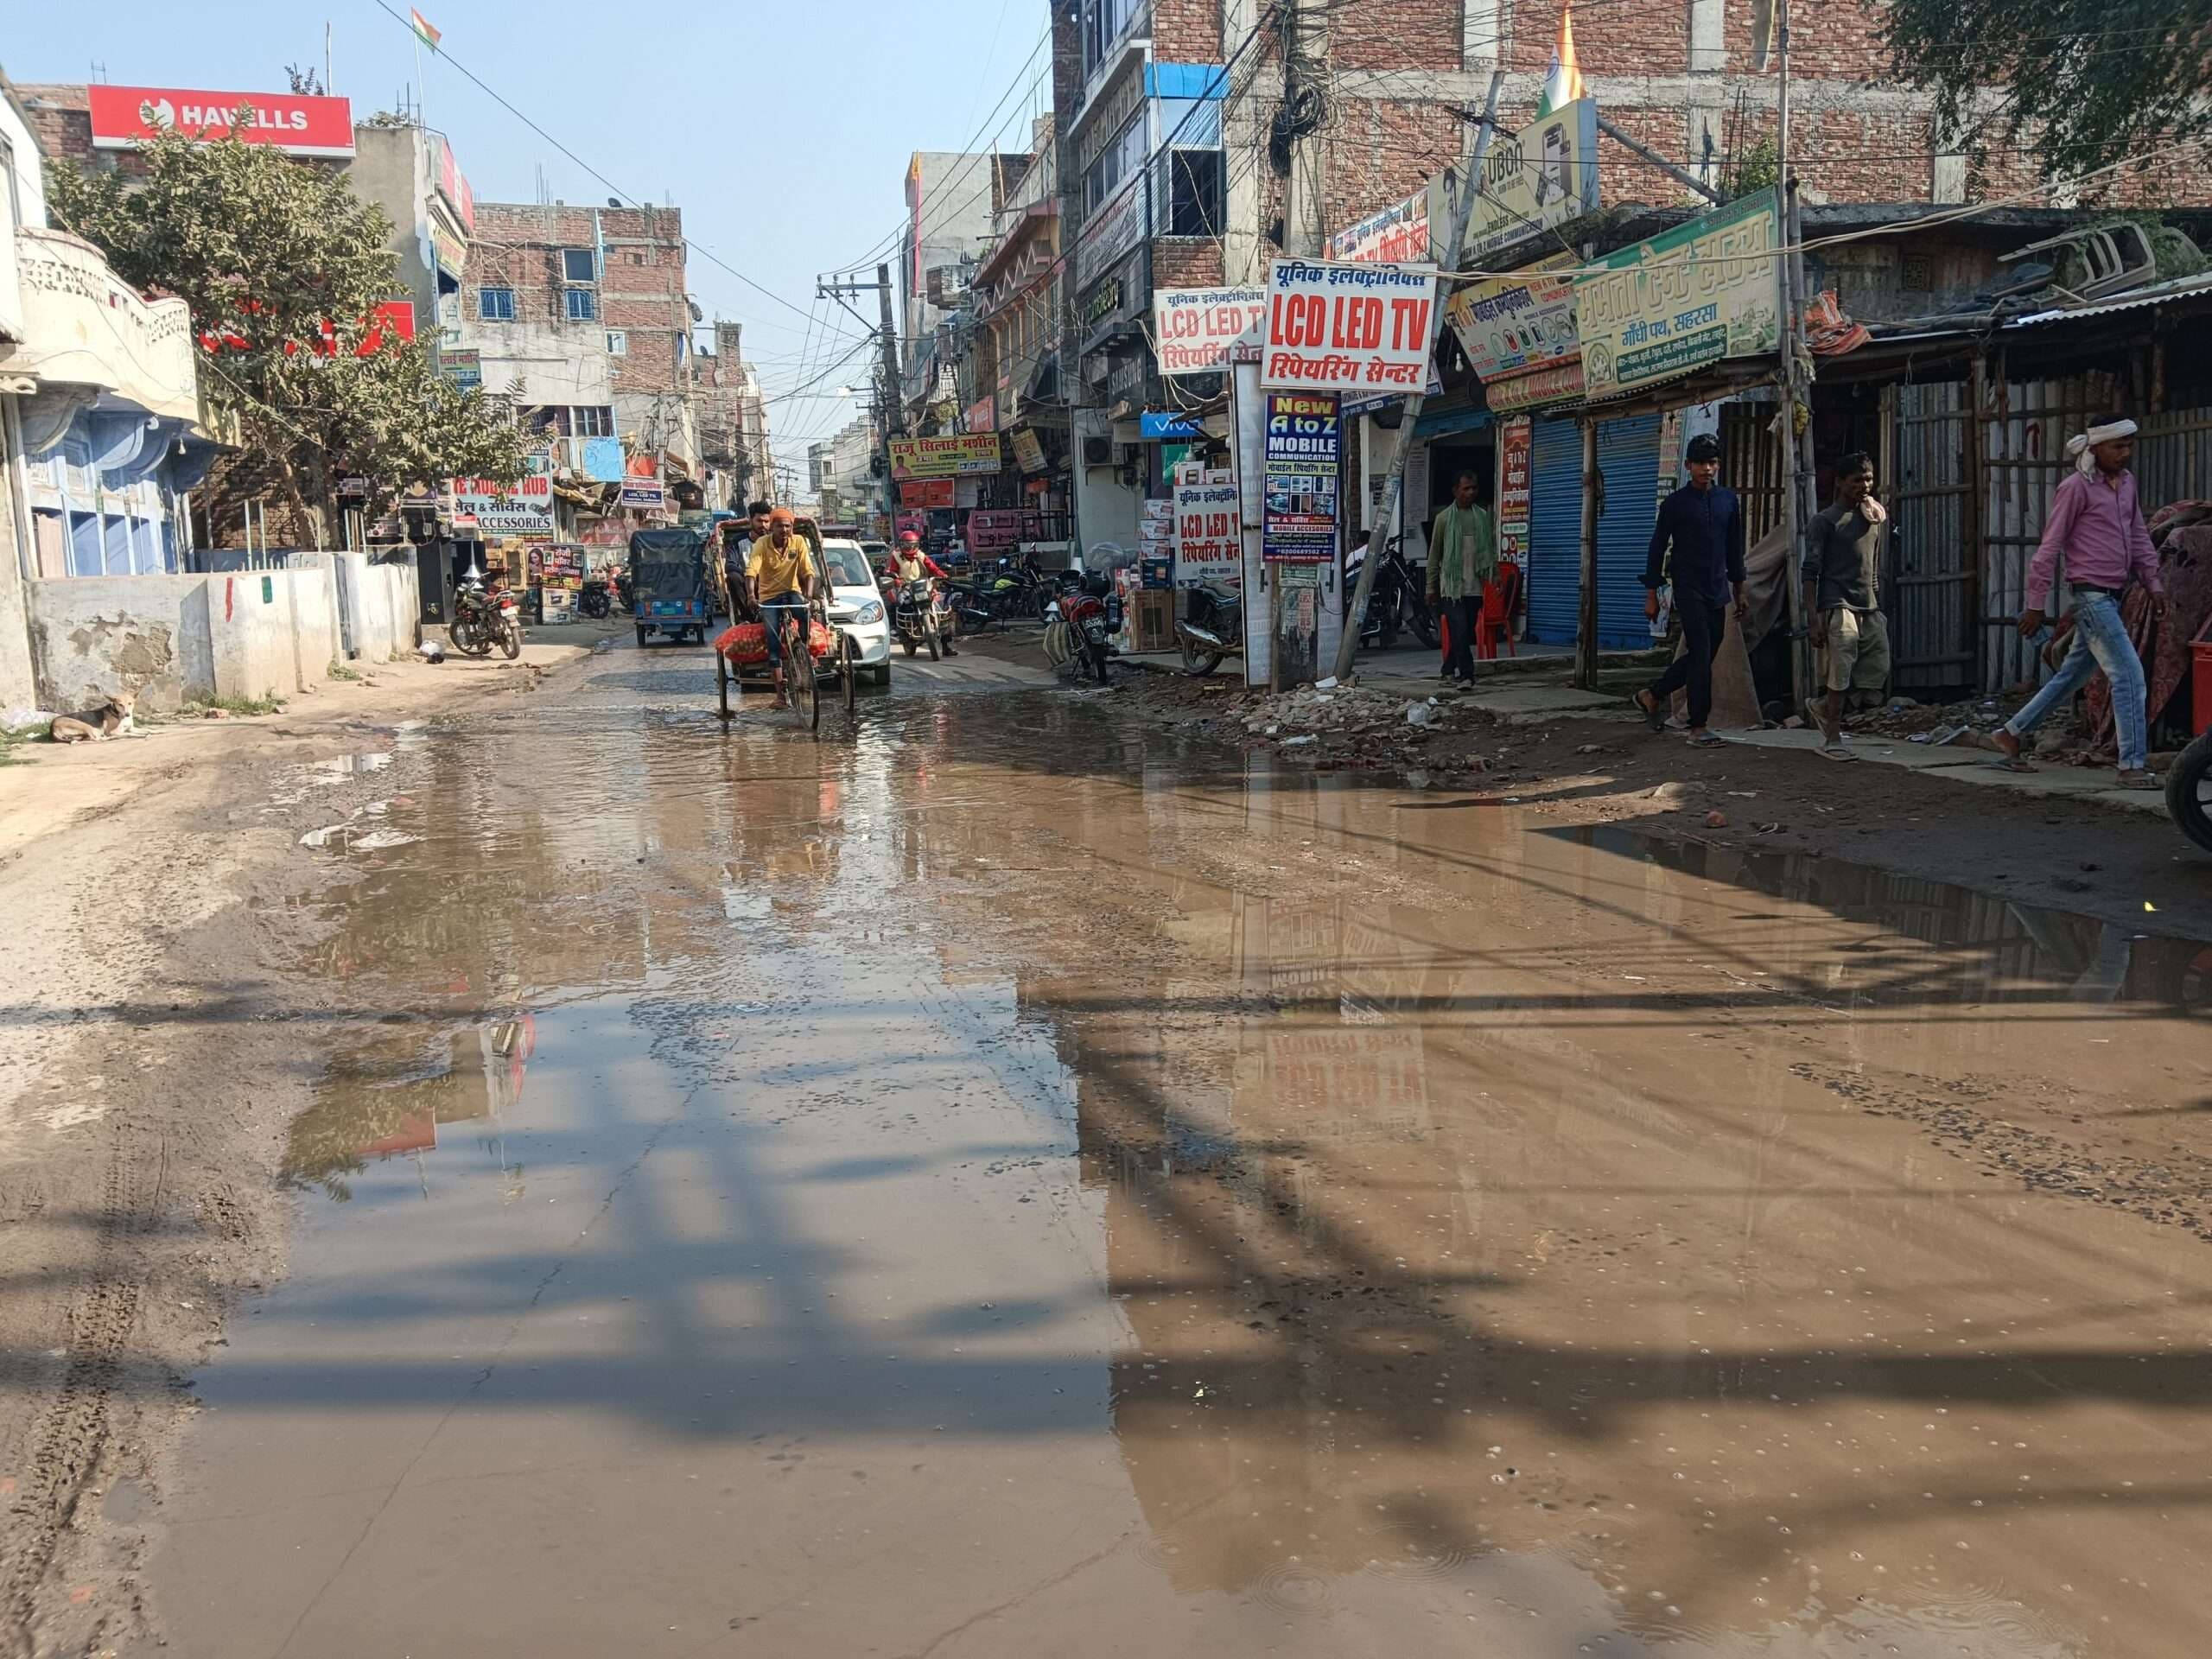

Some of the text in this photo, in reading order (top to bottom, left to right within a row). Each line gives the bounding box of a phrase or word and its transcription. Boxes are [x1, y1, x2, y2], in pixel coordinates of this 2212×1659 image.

[182, 105, 308, 130] HAVELLS
[1276, 261, 1325, 288] यूनिक
[1160, 308, 1199, 339] LCD
[1205, 306, 1243, 336] LED
[1270, 293, 1326, 347] LCD
[1332, 295, 1383, 350] LED
[1391, 297, 1430, 352] TV
[1673, 302, 1718, 332] सहरसा
[1161, 340, 1231, 369] रिपेयरिंग
[1111, 357, 1141, 397] SAMSUNG
[1268, 352, 1423, 385] रिपेयरिंग सेन्टर
[1275, 397, 1334, 414] New
[1154, 418, 1203, 432] vivo
[1270, 416, 1337, 434] A to Z
[918, 438, 960, 452] सिलाई
[1268, 437, 1337, 454] MOBILE
[1268, 453, 1336, 461] COMMUNICATION
[523, 476, 548, 494] HUB
[479, 503, 486, 512] &
[1179, 489, 1201, 506] यूनिक
[476, 517, 550, 529] ACCESSORIES
[1179, 514, 1202, 538] LCD
[1206, 513, 1228, 537] LED
[1181, 539, 1222, 563] रिपेयरिंग
